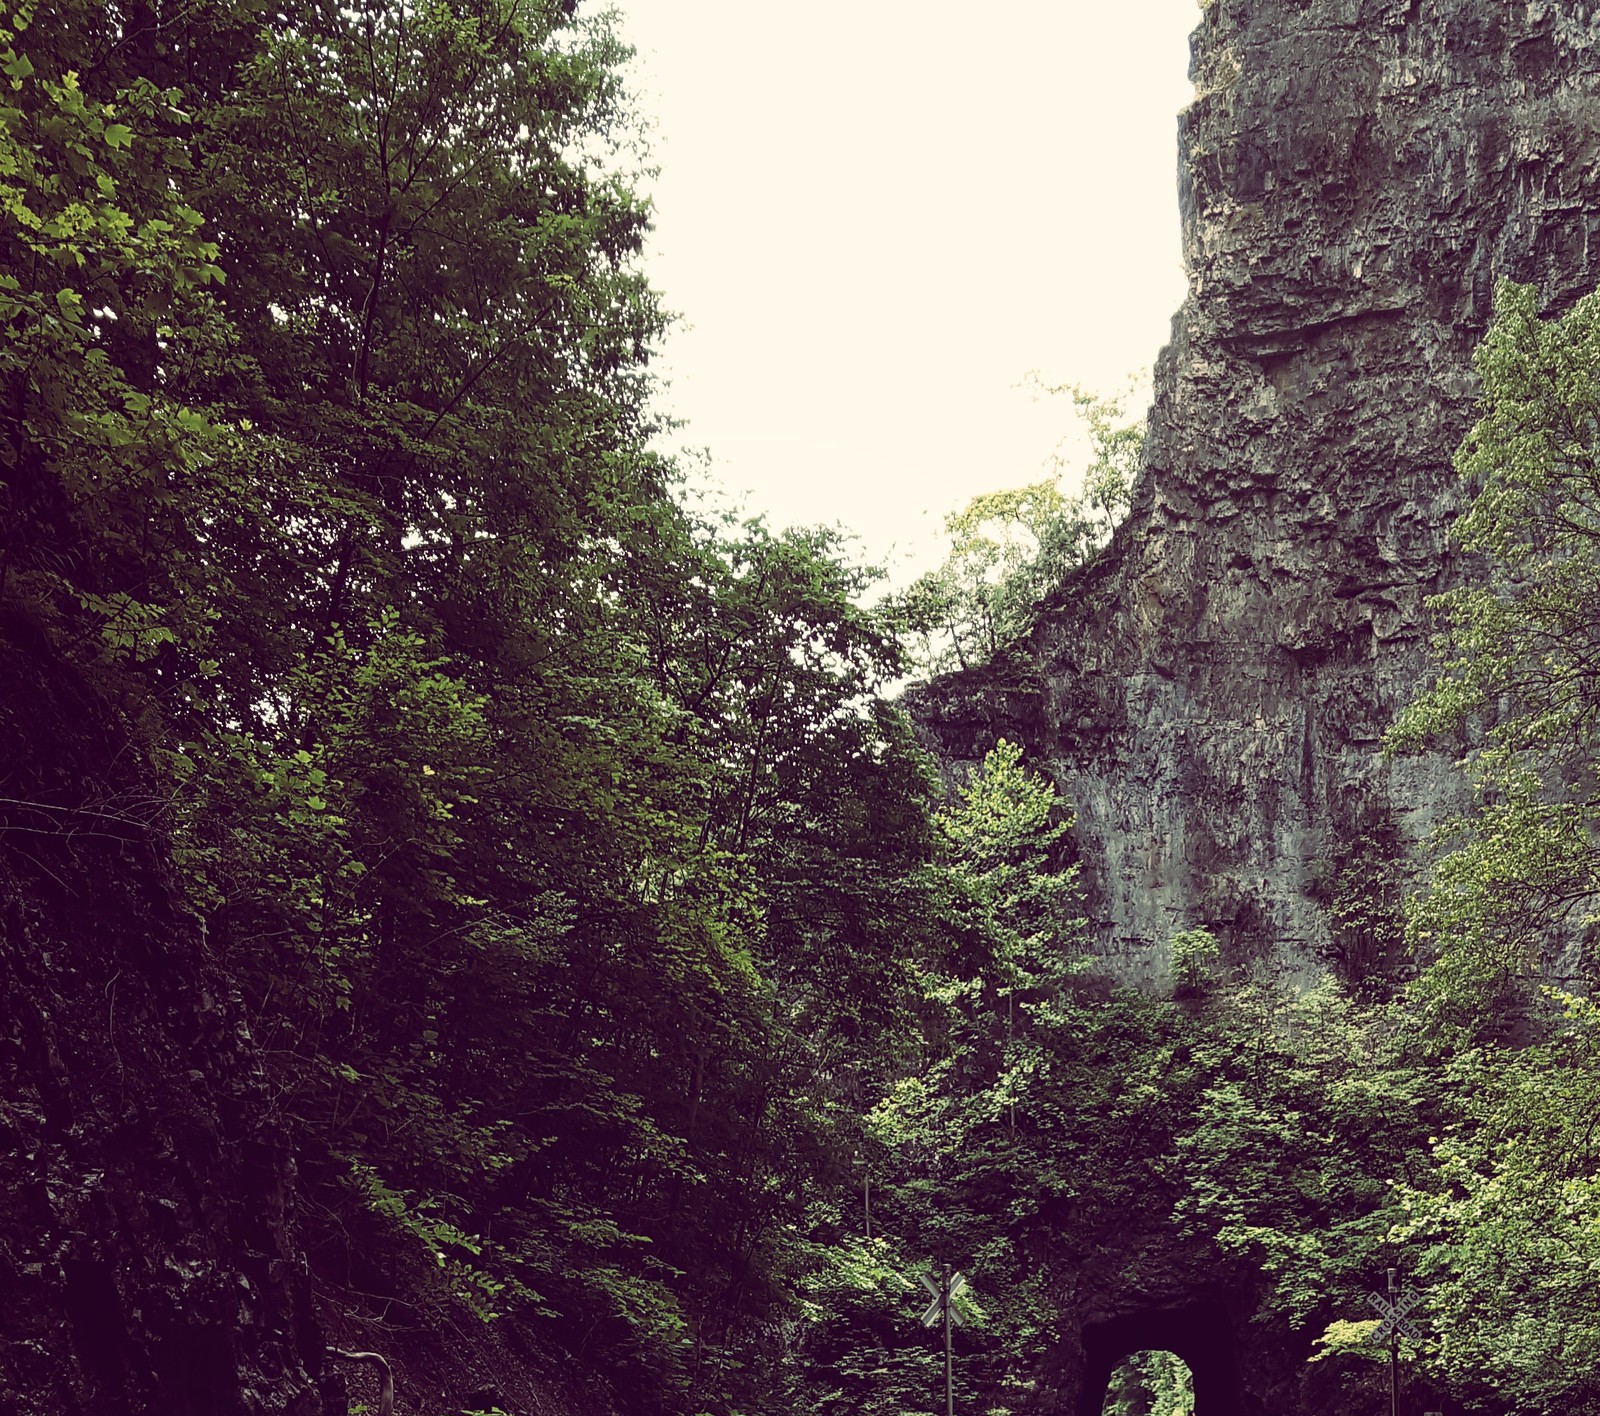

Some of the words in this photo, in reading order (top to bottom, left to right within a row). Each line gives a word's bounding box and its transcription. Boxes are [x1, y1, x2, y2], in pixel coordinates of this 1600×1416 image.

[1369, 1294, 1391, 1316] RAIL
[1397, 1318, 1419, 1340] ROAD
[1371, 1293, 1418, 1341] CROSSING
